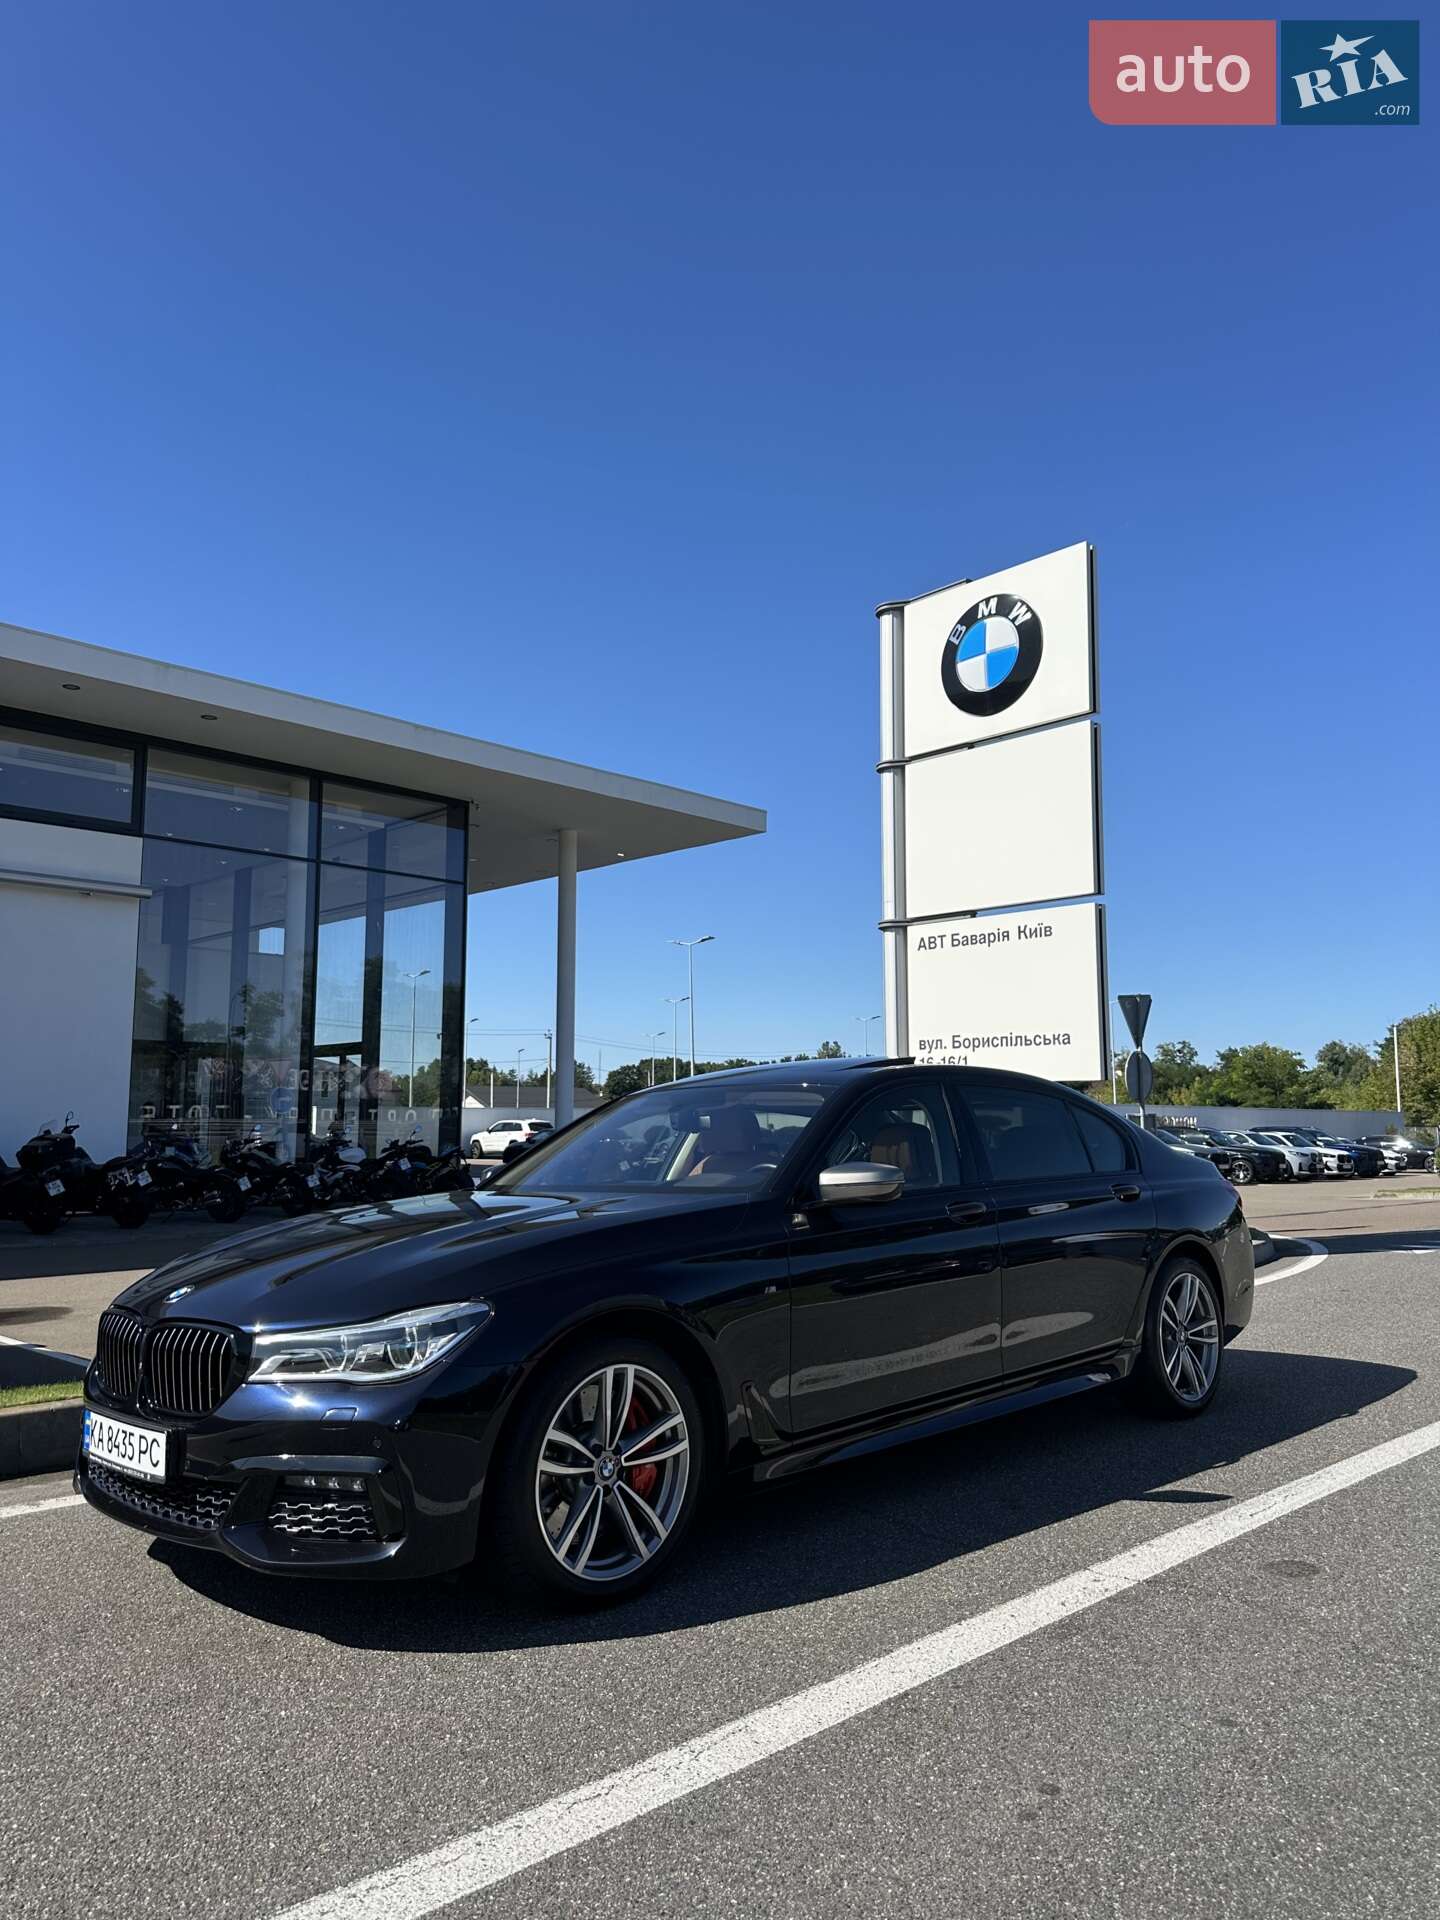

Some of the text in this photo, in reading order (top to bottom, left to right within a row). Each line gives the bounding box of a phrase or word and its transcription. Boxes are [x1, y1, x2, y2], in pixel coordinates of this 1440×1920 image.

[949, 597, 1032, 645] BMW
[917, 923, 1053, 951] АВТ Баварія Київ
[919, 1032, 1071, 1054] вул. Бориспільська
[90, 1419, 104, 1451] KA
[107, 1425, 135, 1461] 8435
[138, 1434, 161, 1468] PC
